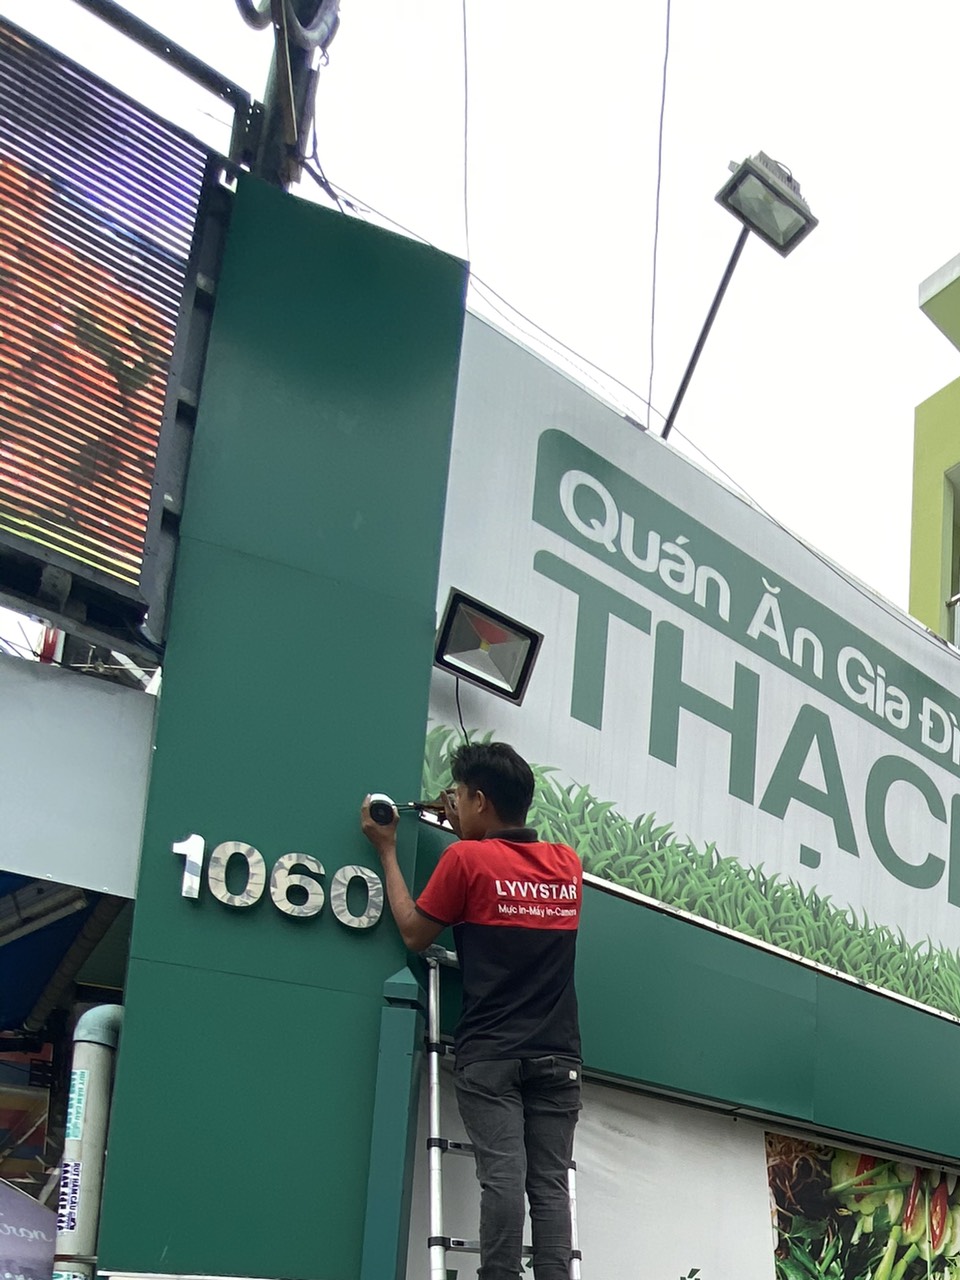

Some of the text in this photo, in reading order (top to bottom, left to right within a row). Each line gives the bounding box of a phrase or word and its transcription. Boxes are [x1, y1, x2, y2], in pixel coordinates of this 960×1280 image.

[559, 469, 731, 623] Quán
[746, 577, 824, 680] Ăn
[837, 646, 910, 729] Gia
[172, 833, 385, 930] 1060
[495, 880, 577, 900] LYVYSTAR
